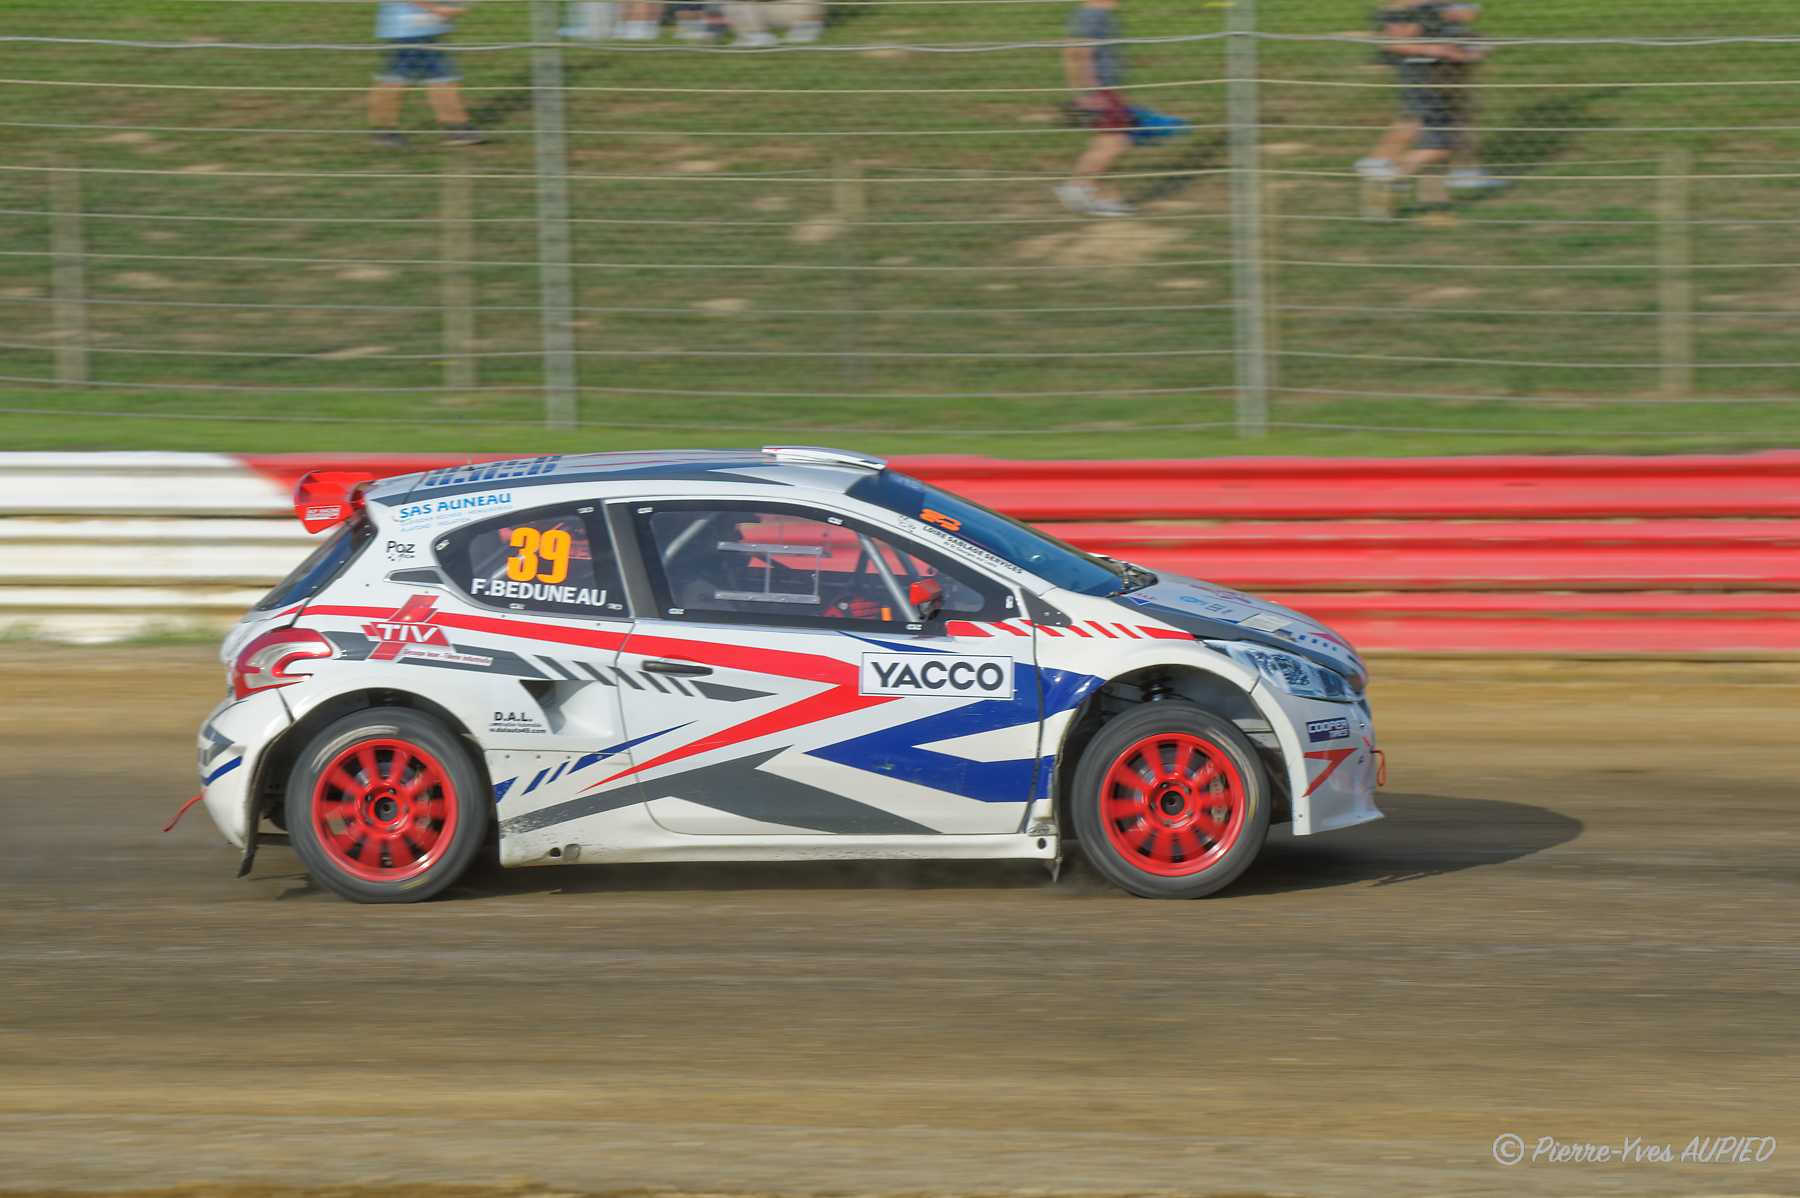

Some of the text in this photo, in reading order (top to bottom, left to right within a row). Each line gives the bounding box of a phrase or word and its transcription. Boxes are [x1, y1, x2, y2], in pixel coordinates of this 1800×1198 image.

[400, 493, 511, 518] SAS AUNEAU
[507, 527, 572, 584] 39
[471, 578, 607, 607] F.BEDUNEAU
[376, 623, 438, 643] TIV
[870, 661, 1004, 691] YACCO
[494, 711, 533, 722] D.A.L.
